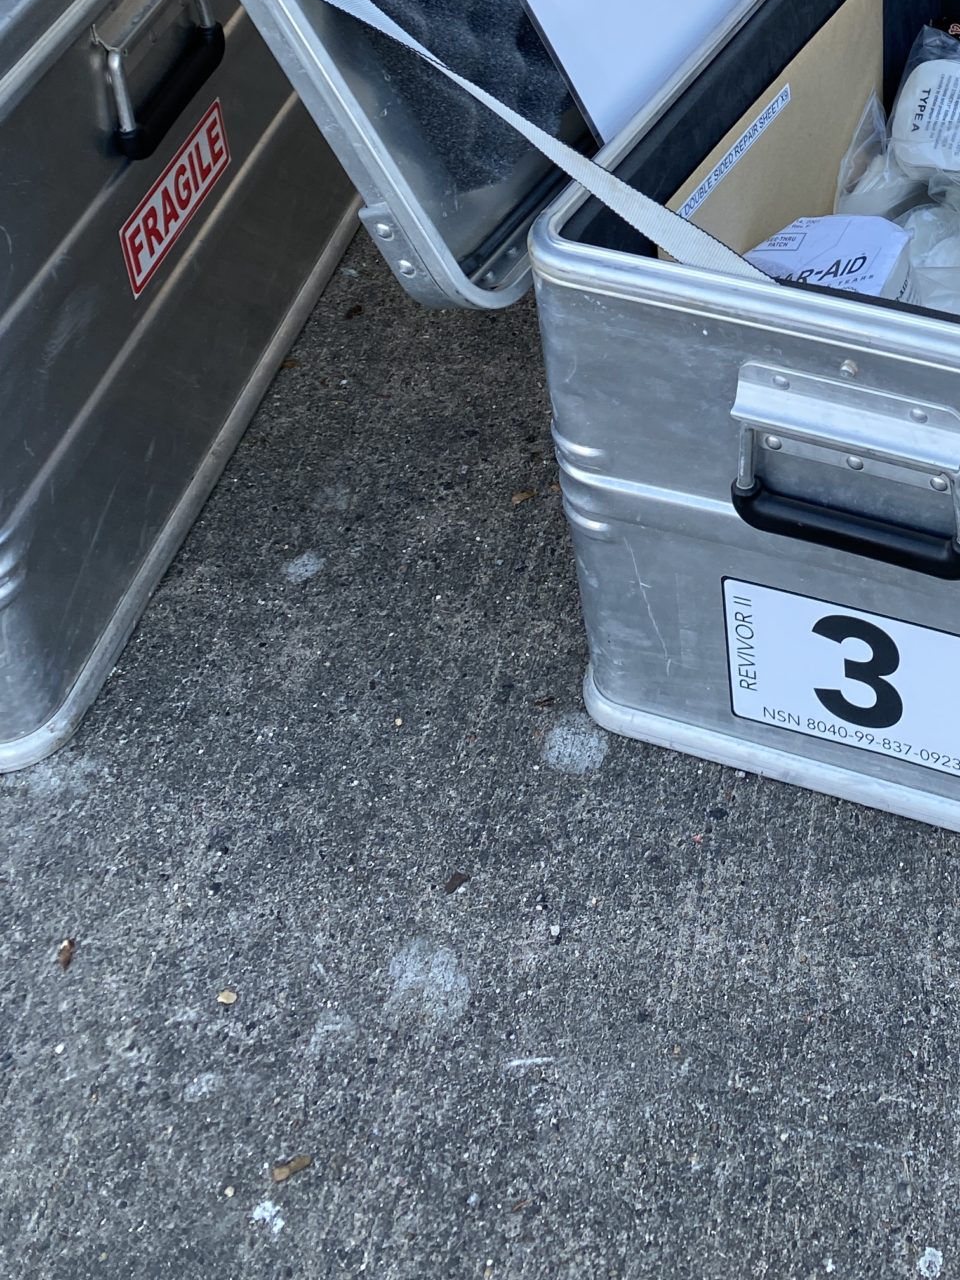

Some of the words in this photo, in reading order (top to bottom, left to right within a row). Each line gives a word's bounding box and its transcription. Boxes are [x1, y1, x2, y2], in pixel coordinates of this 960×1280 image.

[911, 123, 920, 132] A
[915, 88, 931, 121] TYPE
[684, 178, 712, 215] DOUBLE
[714, 153, 734, 180] SIDED
[734, 124, 758, 159] REPAIR
[759, 99, 780, 130] SHEET
[128, 117, 224, 277] FRAGILE
[733, 596, 753, 607] II
[734, 611, 757, 692] REVIVOR
[812, 615, 903, 729] 3
[763, 706, 800, 726] NSN
